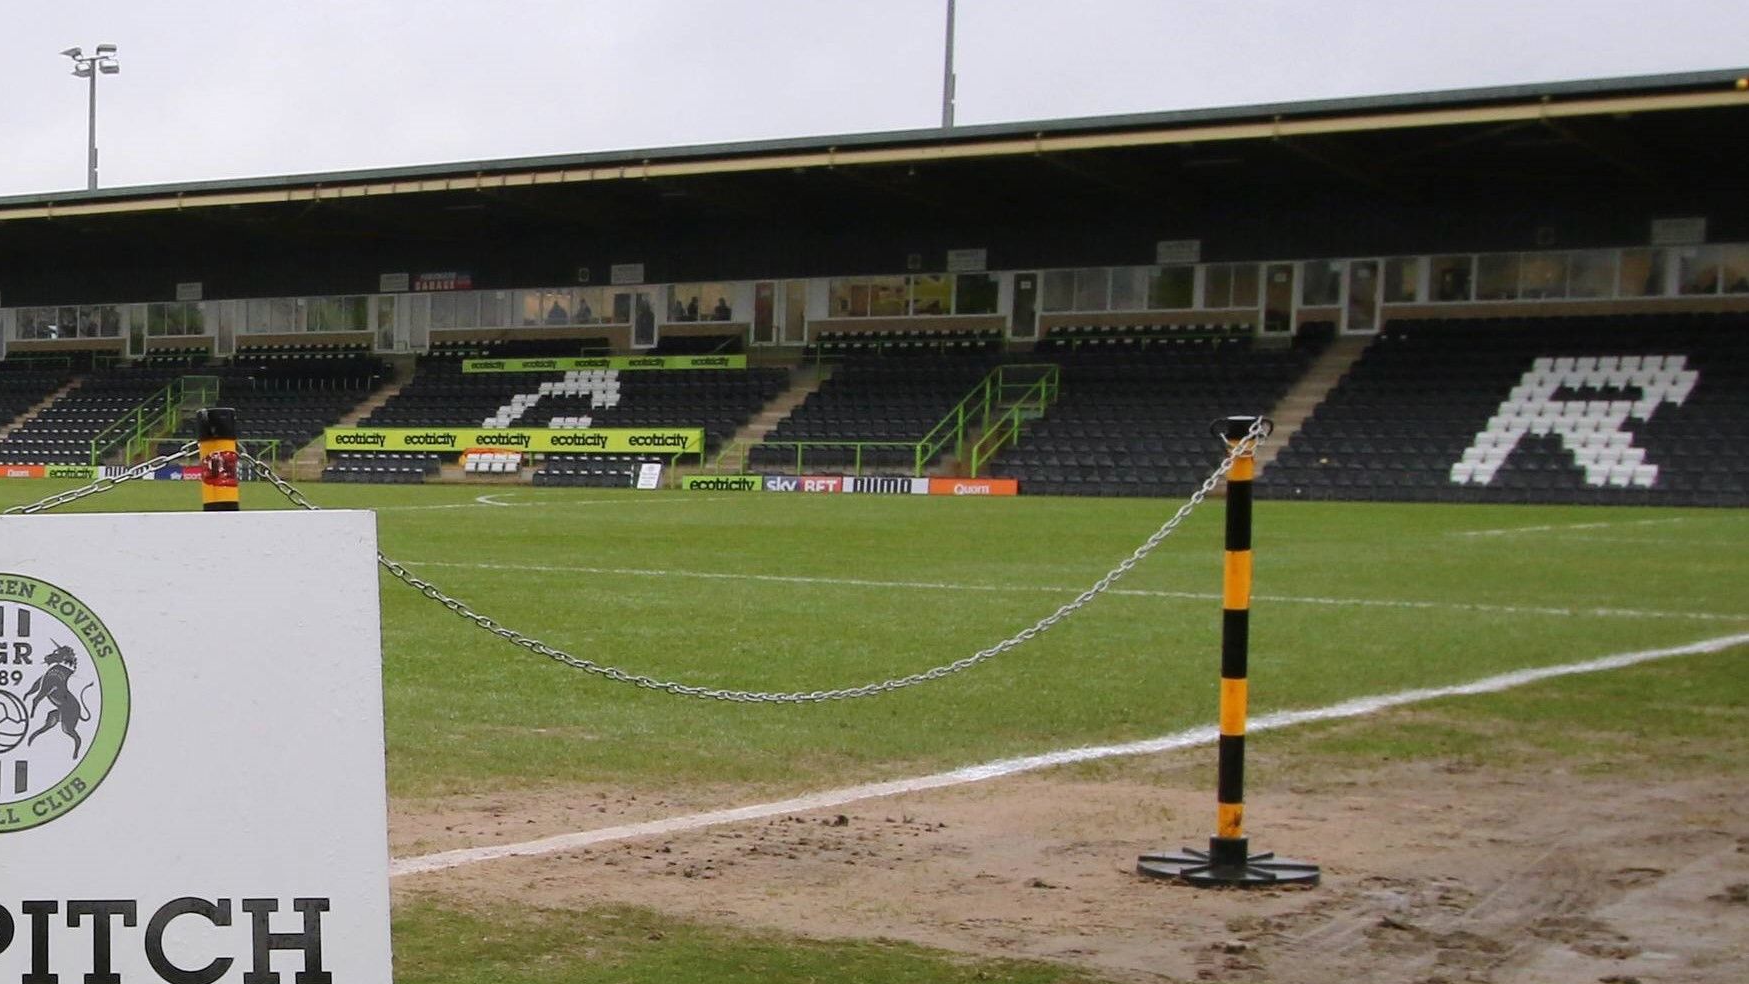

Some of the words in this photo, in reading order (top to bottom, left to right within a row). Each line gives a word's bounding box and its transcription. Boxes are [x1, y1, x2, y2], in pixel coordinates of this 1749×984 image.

[1450, 355, 1699, 487] R
[335, 433, 386, 447] ecotricity
[404, 434, 457, 448] ecotricity
[476, 433, 530, 448] ecotricity
[550, 433, 608, 448] ecotricity
[628, 433, 689, 449] ecotricity
[49, 467, 94, 479] ecotricity
[689, 476, 755, 492] ecotricity
[766, 476, 797, 492] sky
[953, 483, 990, 496] Quorn
[45, 592, 114, 659] ROVERS
[32, 777, 87, 818] CLUB
